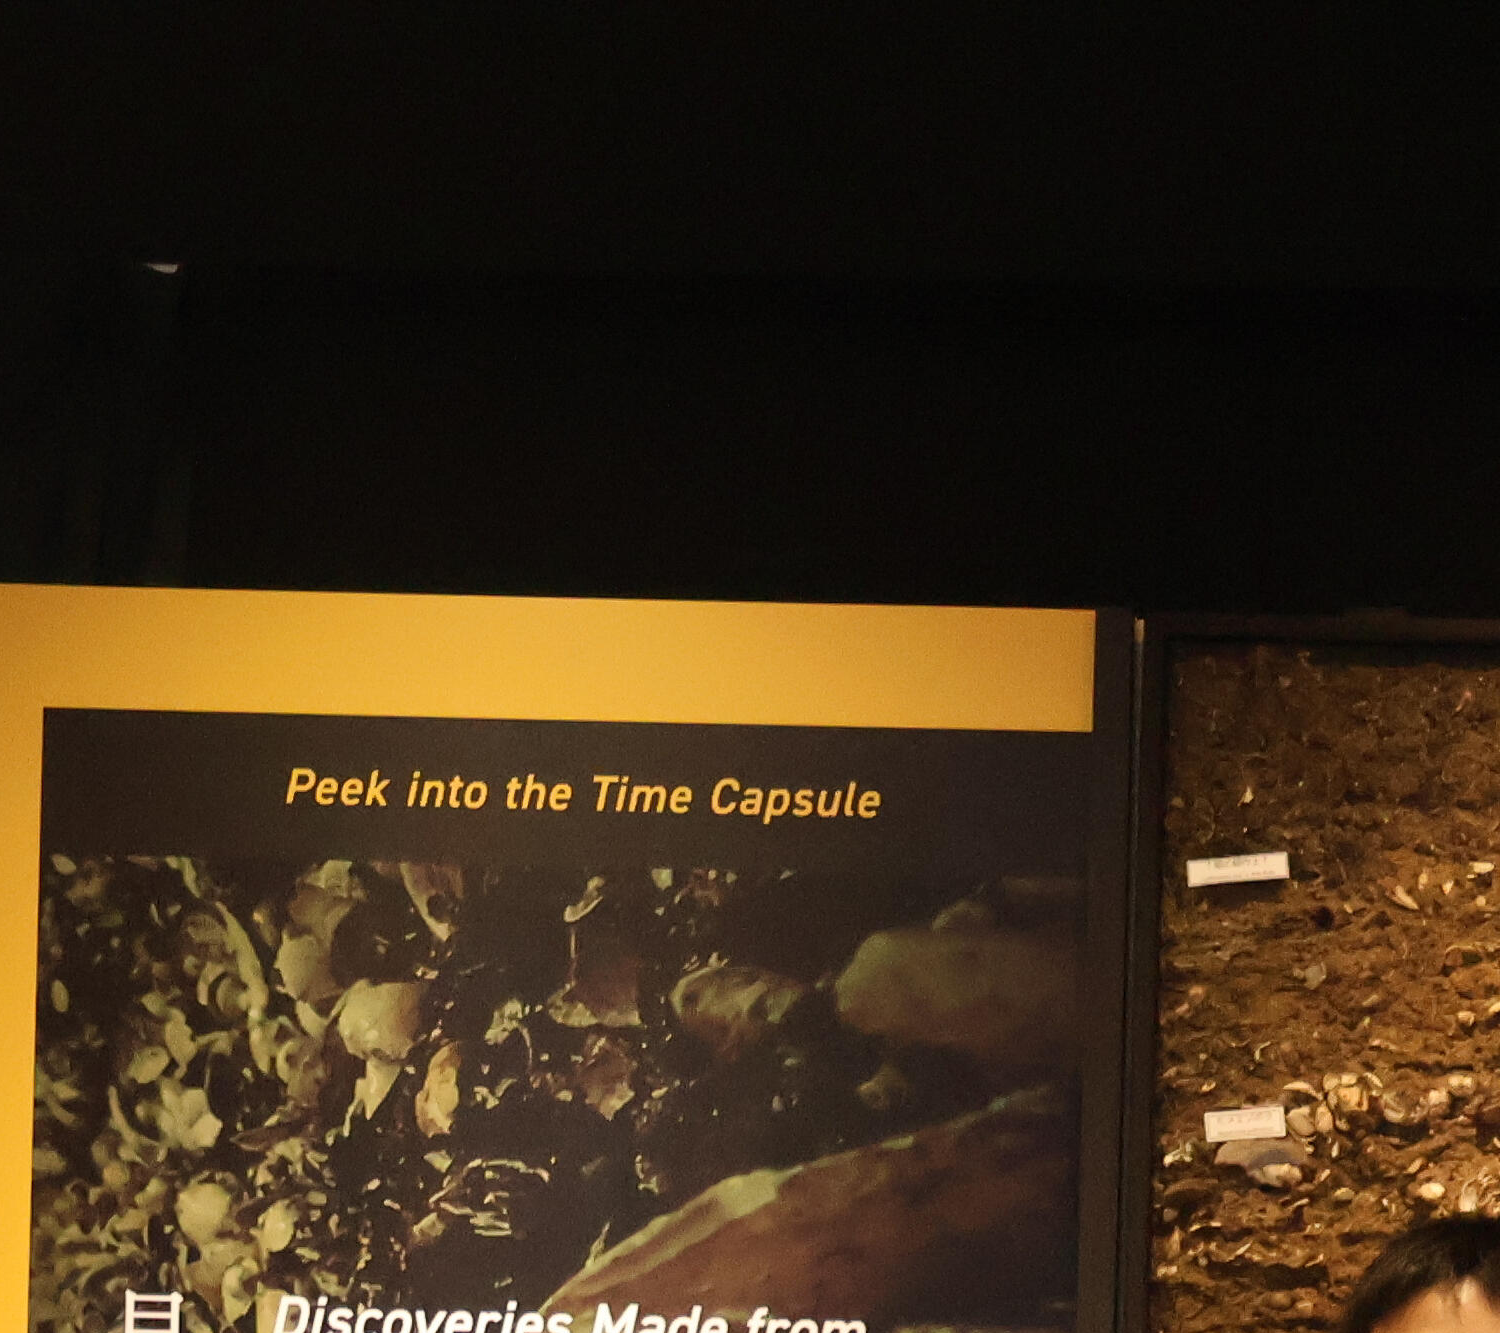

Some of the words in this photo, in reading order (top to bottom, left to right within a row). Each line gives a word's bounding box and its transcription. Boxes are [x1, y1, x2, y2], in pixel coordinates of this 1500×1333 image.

[286, 768, 389, 806] Peek
[407, 771, 488, 809] into
[505, 774, 572, 811] the
[594, 775, 692, 813] Time
[711, 777, 881, 824] Capsule
